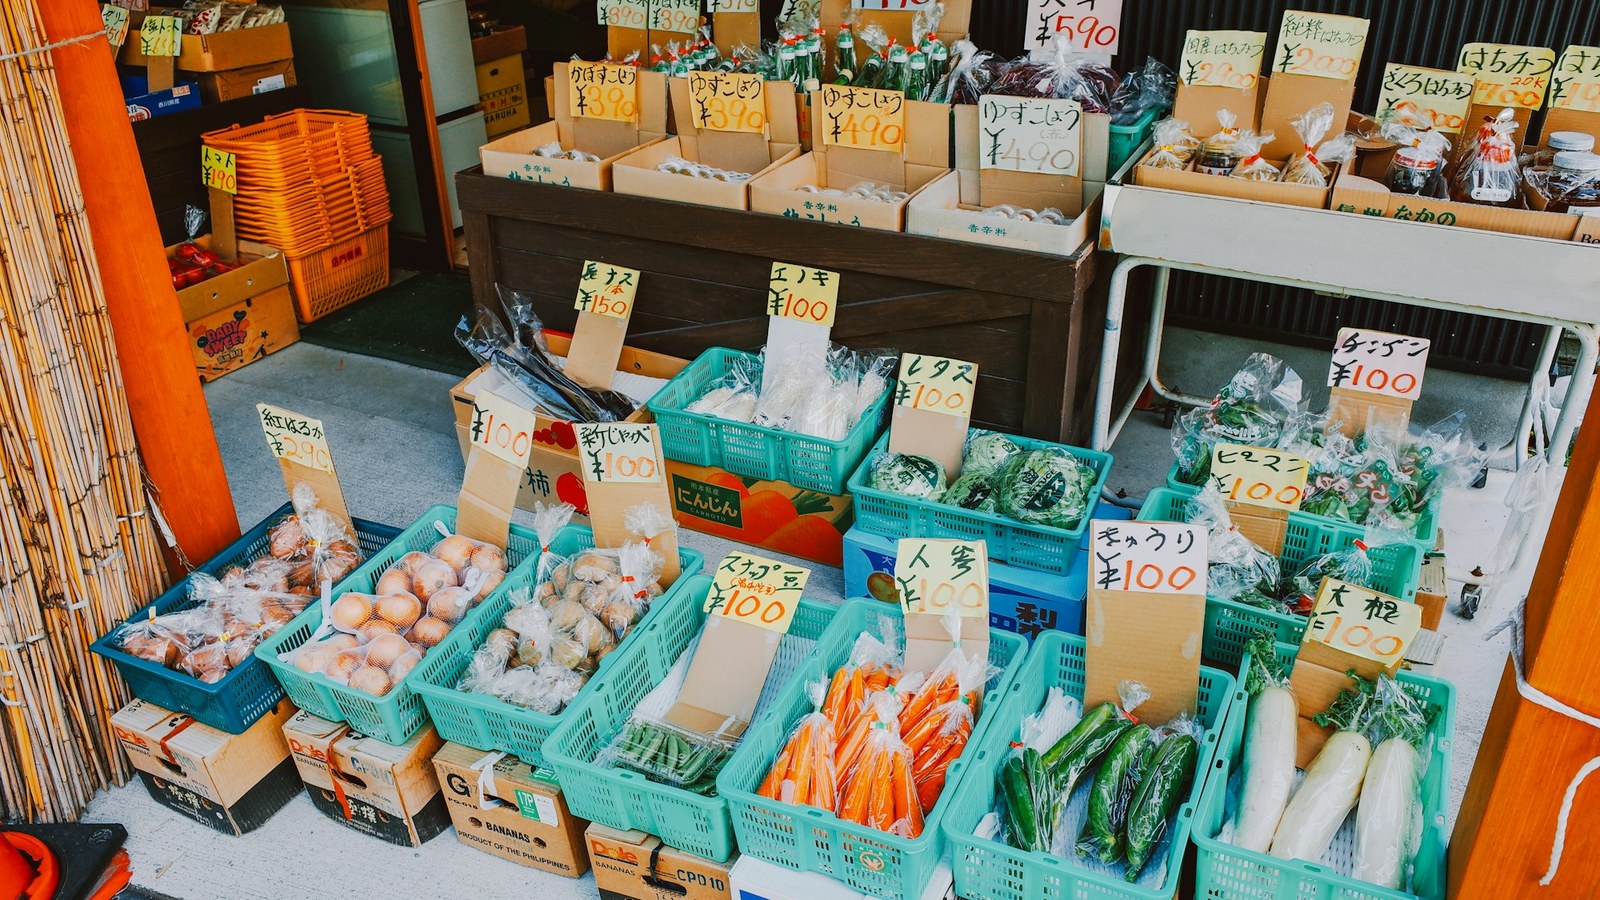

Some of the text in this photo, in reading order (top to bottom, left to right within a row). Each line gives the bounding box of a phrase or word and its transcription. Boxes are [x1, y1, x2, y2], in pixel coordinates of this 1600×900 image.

[600, 5, 644, 25] ¥390
[653, 8, 698, 31] ¥390
[1035, 10, 1117, 48] ¥590
[1187, 60, 1256, 87] ¥2900
[1278, 43, 1357, 75] ¥2000
[1462, 47, 1553, 75] はちみつ
[570, 64, 636, 85] かぼすこしょう
[691, 73, 761, 99] ゆずこしょう
[1384, 67, 1474, 100] ざくろはちみつ
[576, 84, 637, 117] ¥390
[696, 96, 765, 129] ¥390
[824, 87, 902, 114] ゆずこしょう
[828, 111, 902, 146] ¥490
[984, 100, 1080, 131] ゆずこしょう
[205, 147, 233, 168] トマト
[984, 127, 1075, 170] ¥490
[203, 165, 236, 190] ¥190
[803, 201, 838, 213] 香辛料
[968, 224, 1007, 237] 香辛料
[581, 262, 633, 286] 長ナス
[769, 267, 830, 287] エノキ
[579, 288, 627, 315] ¥150
[769, 288, 828, 321] ¥100
[204, 331, 247, 357] SWEET
[205, 320, 240, 343] BABY
[908, 355, 973, 384] レタス
[1332, 359, 1416, 393] ¥100
[895, 380, 964, 409] ¥100
[261, 407, 323, 440] 紅はるか
[471, 402, 530, 457] ¥100
[266, 430, 329, 468] ¥290
[1218, 450, 1304, 472] ピーマン
[587, 449, 656, 481] ¥100
[677, 487, 738, 518] にんじん
[690, 482, 720, 497] 熊本県産
[1210, 472, 1301, 504] ¥100
[1097, 527, 1194, 554] きゅうり
[720, 555, 803, 591] スナップ豆
[909, 544, 975, 580] 人参
[1096, 551, 1196, 591] ¥100
[708, 582, 785, 623] ¥100
[897, 574, 985, 612] ¥100
[1326, 584, 1400, 625] 大根
[1015, 601, 1057, 641] 梨
[1309, 610, 1403, 656] ¥100
[289, 738, 326, 760] Dole
[295, 755, 327, 771] BANANAS
[517, 790, 534, 808] 17P
[485, 821, 530, 843] BANANAS
[458, 830, 570, 871] PRODUCT OF THE PHILIPPINES
[591, 839, 638, 864] Dole
[595, 860, 635, 876] BANANAS
[710, 877, 725, 891] 10
